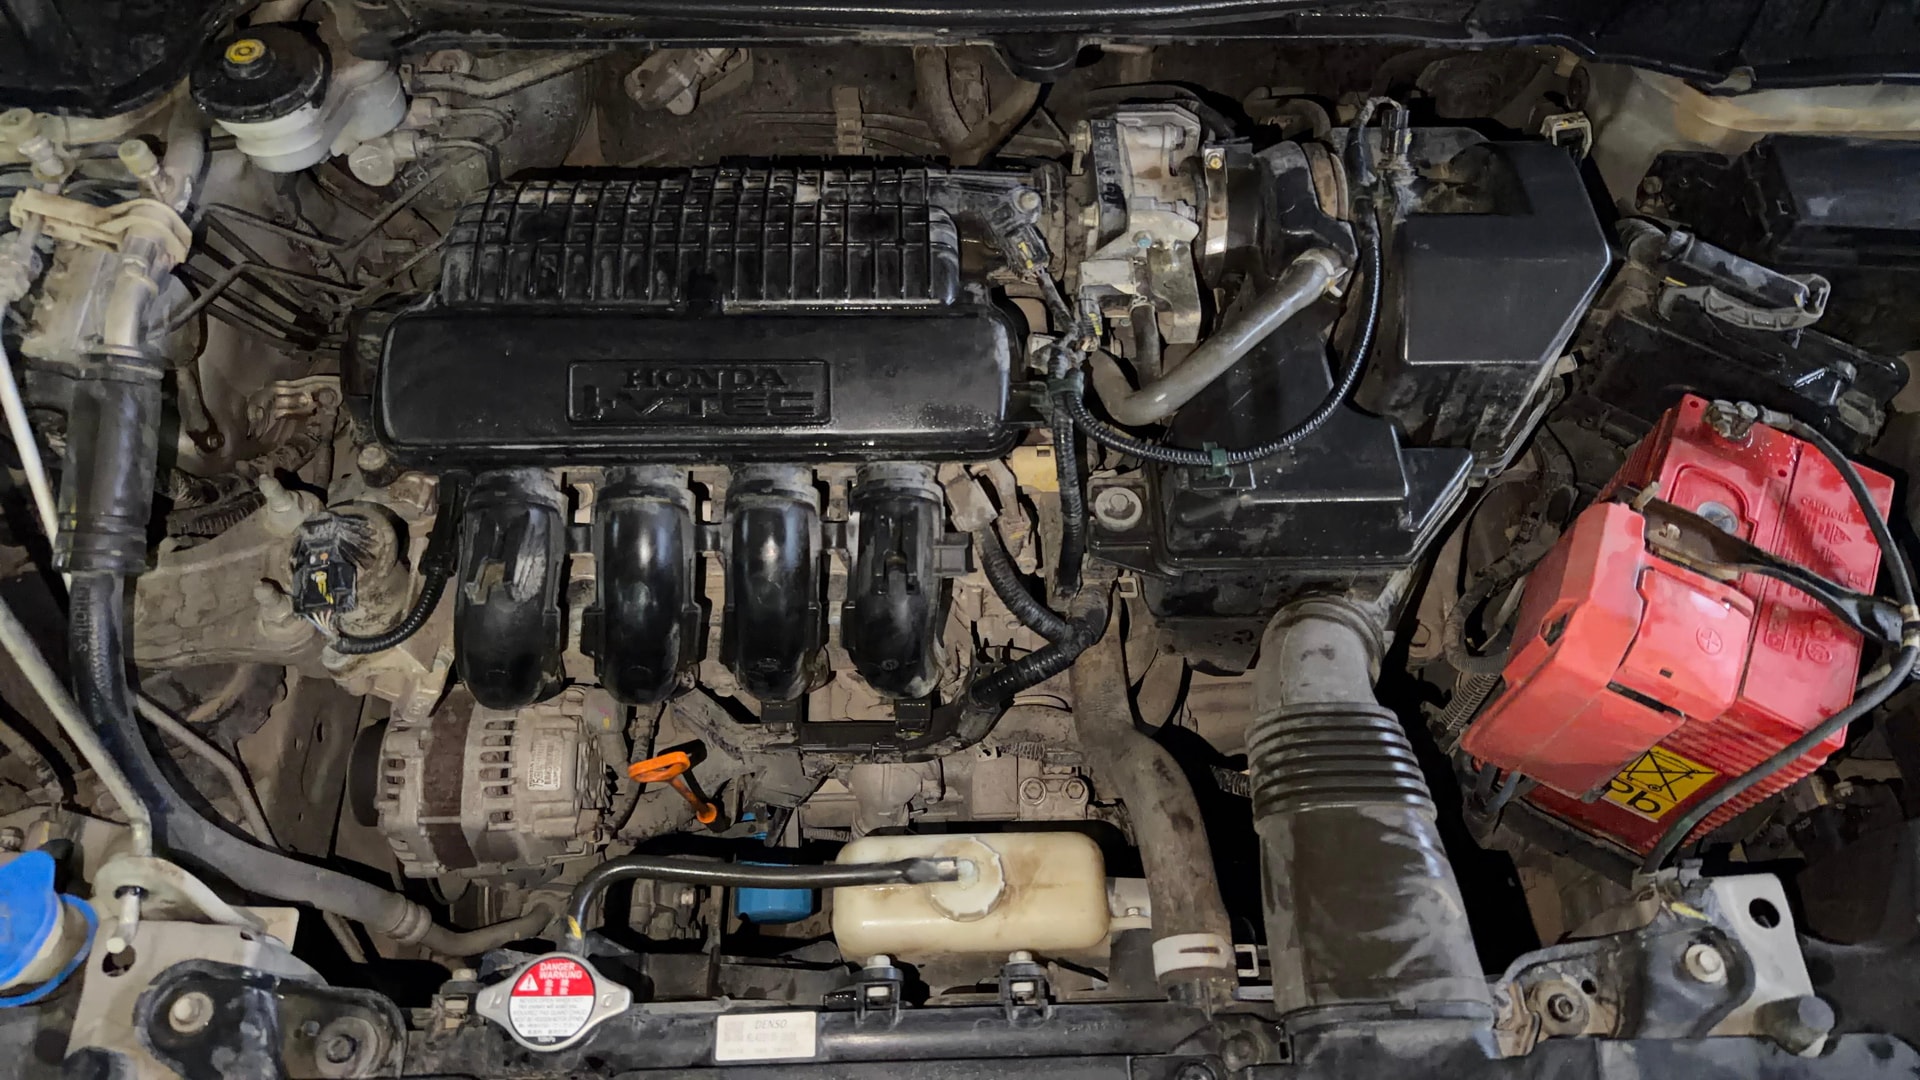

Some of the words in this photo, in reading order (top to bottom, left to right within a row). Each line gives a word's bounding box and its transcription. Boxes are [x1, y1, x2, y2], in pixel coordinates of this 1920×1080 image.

[622, 369, 791, 390] HONDA
[1602, 778, 1661, 813] Pb
[539, 962, 576, 971] DANGER
[538, 970, 583, 979] WARNUNG
[755, 1019, 788, 1029] DENSO
